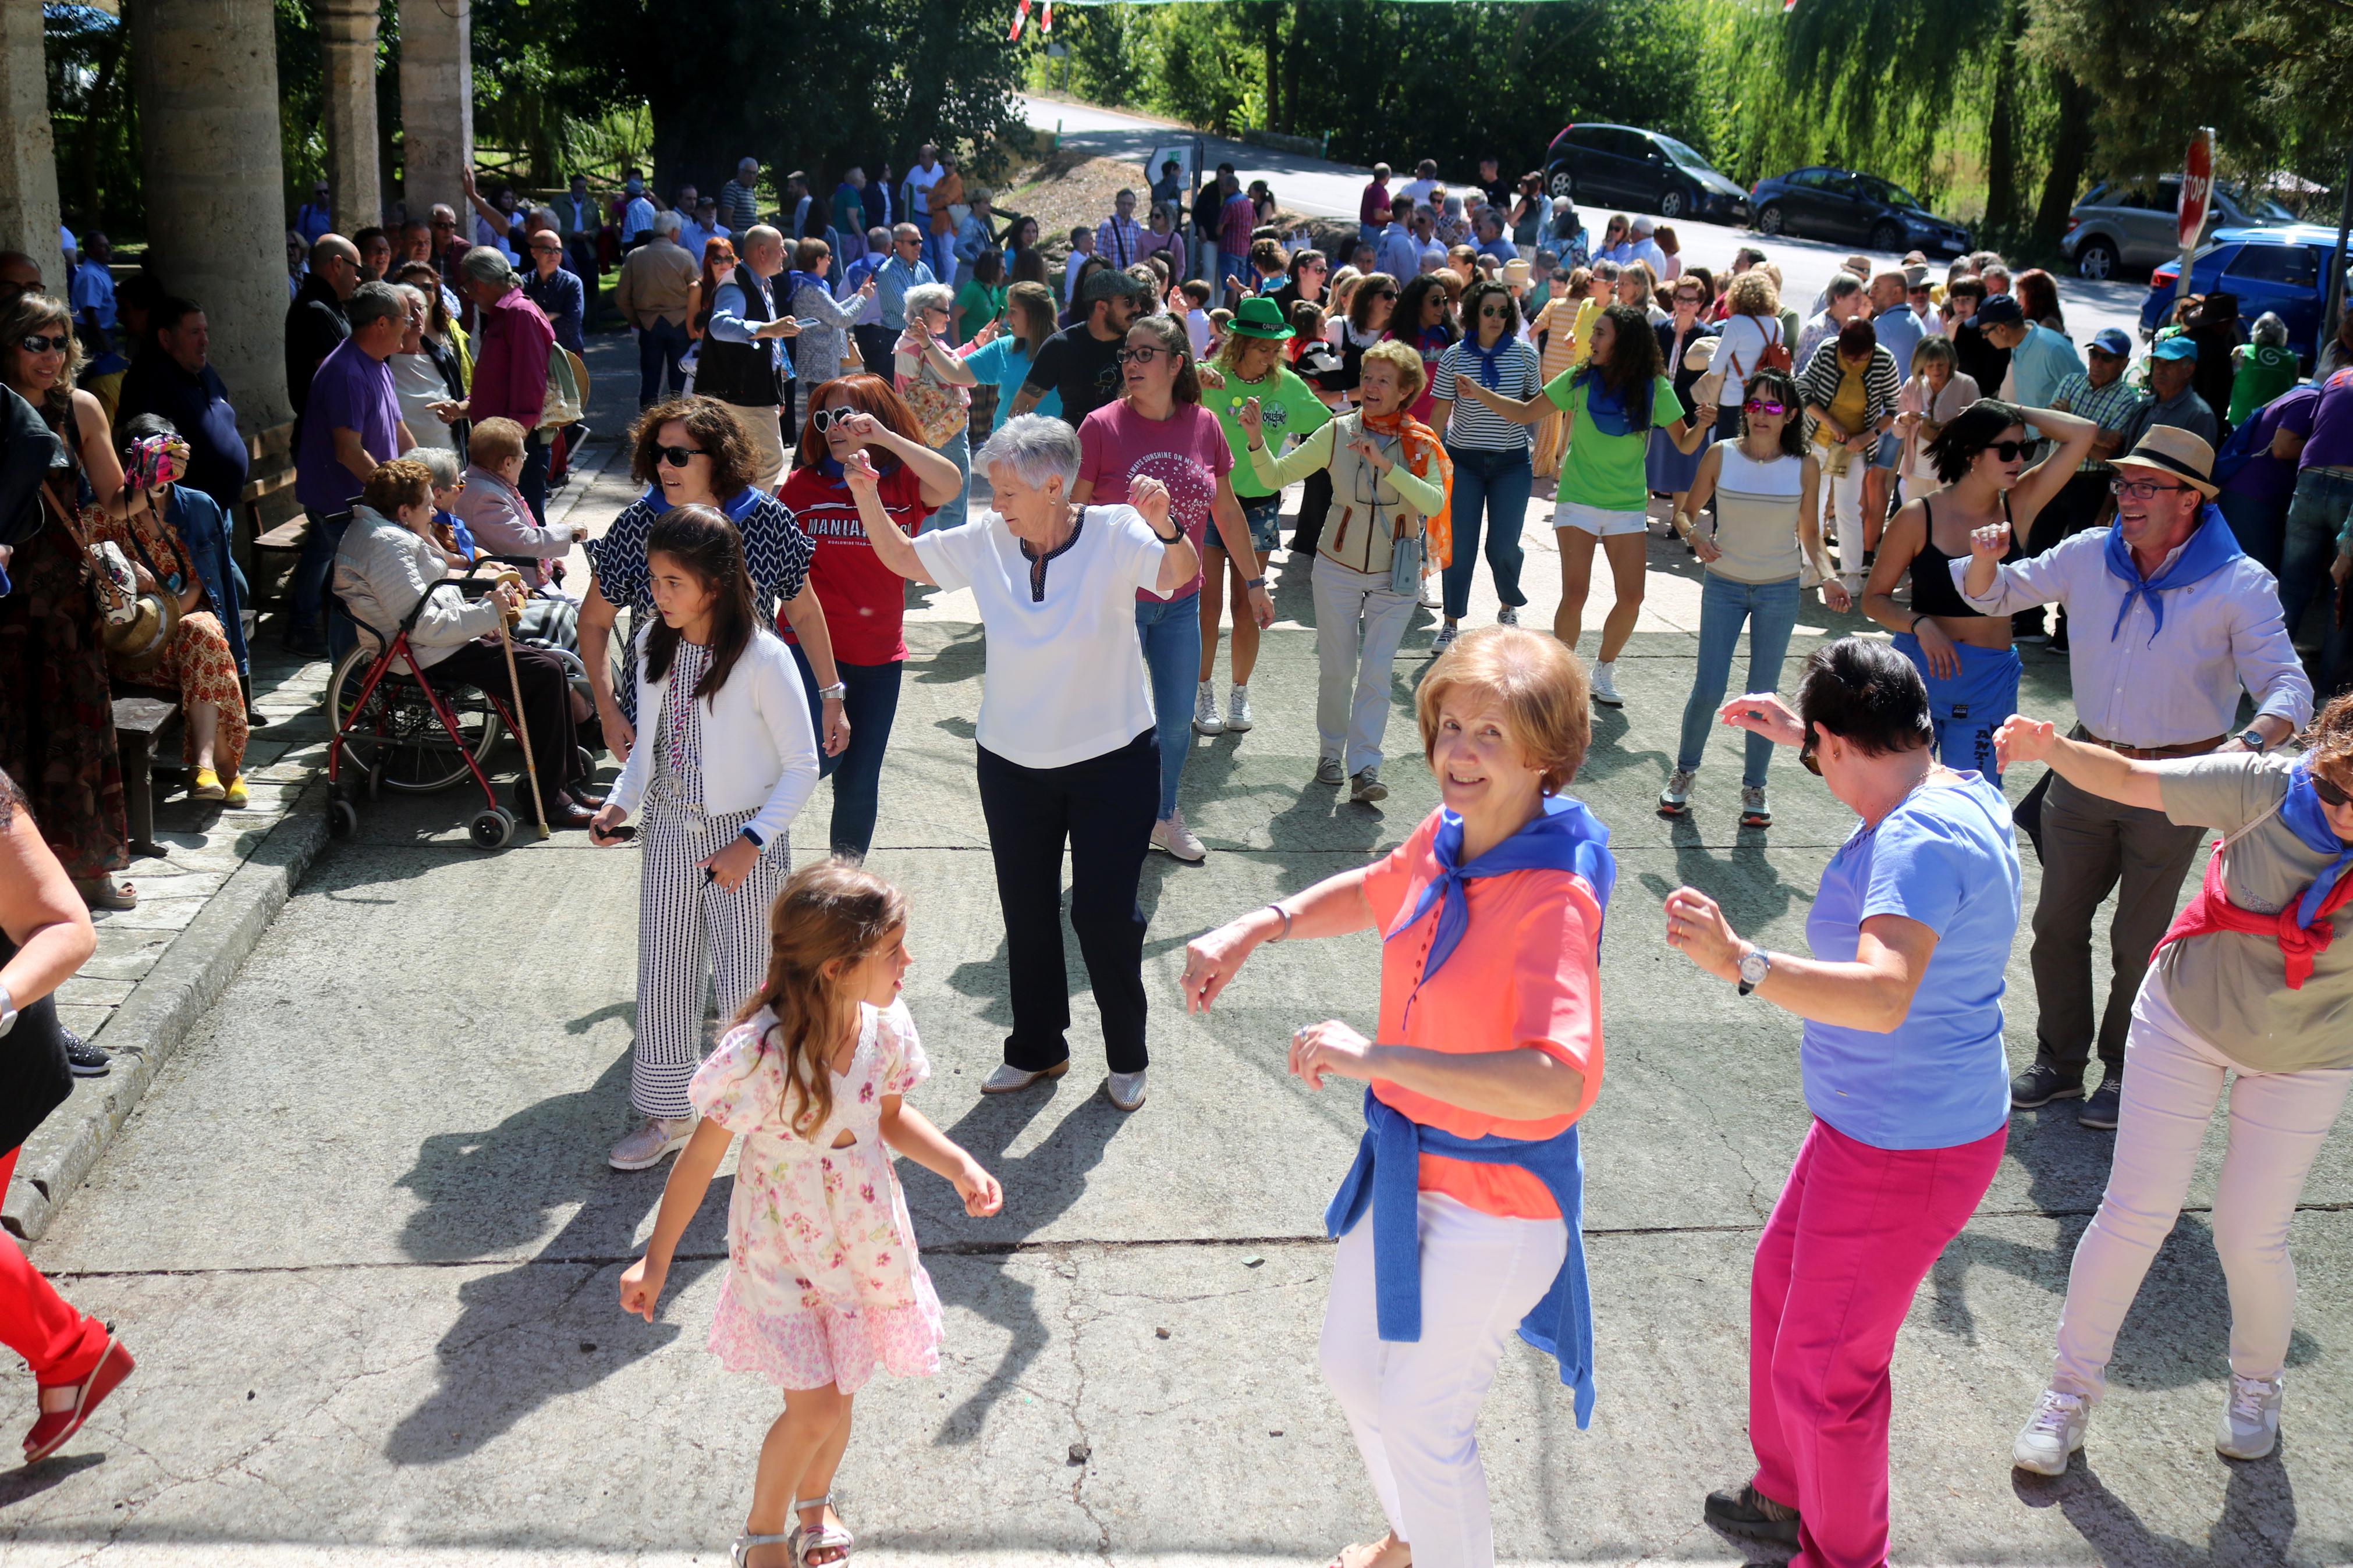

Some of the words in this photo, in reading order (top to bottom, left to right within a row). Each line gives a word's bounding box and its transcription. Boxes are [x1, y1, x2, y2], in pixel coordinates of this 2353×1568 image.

[2182, 174, 2206, 202] STOP
[1126, 459, 1144, 480] ALWAYS
[1142, 451, 1172, 463] SUNSHINE
[1174, 453, 1182, 461] ON
[1184, 457, 1193, 466] MY
[1195, 464, 1209, 478] MIND
